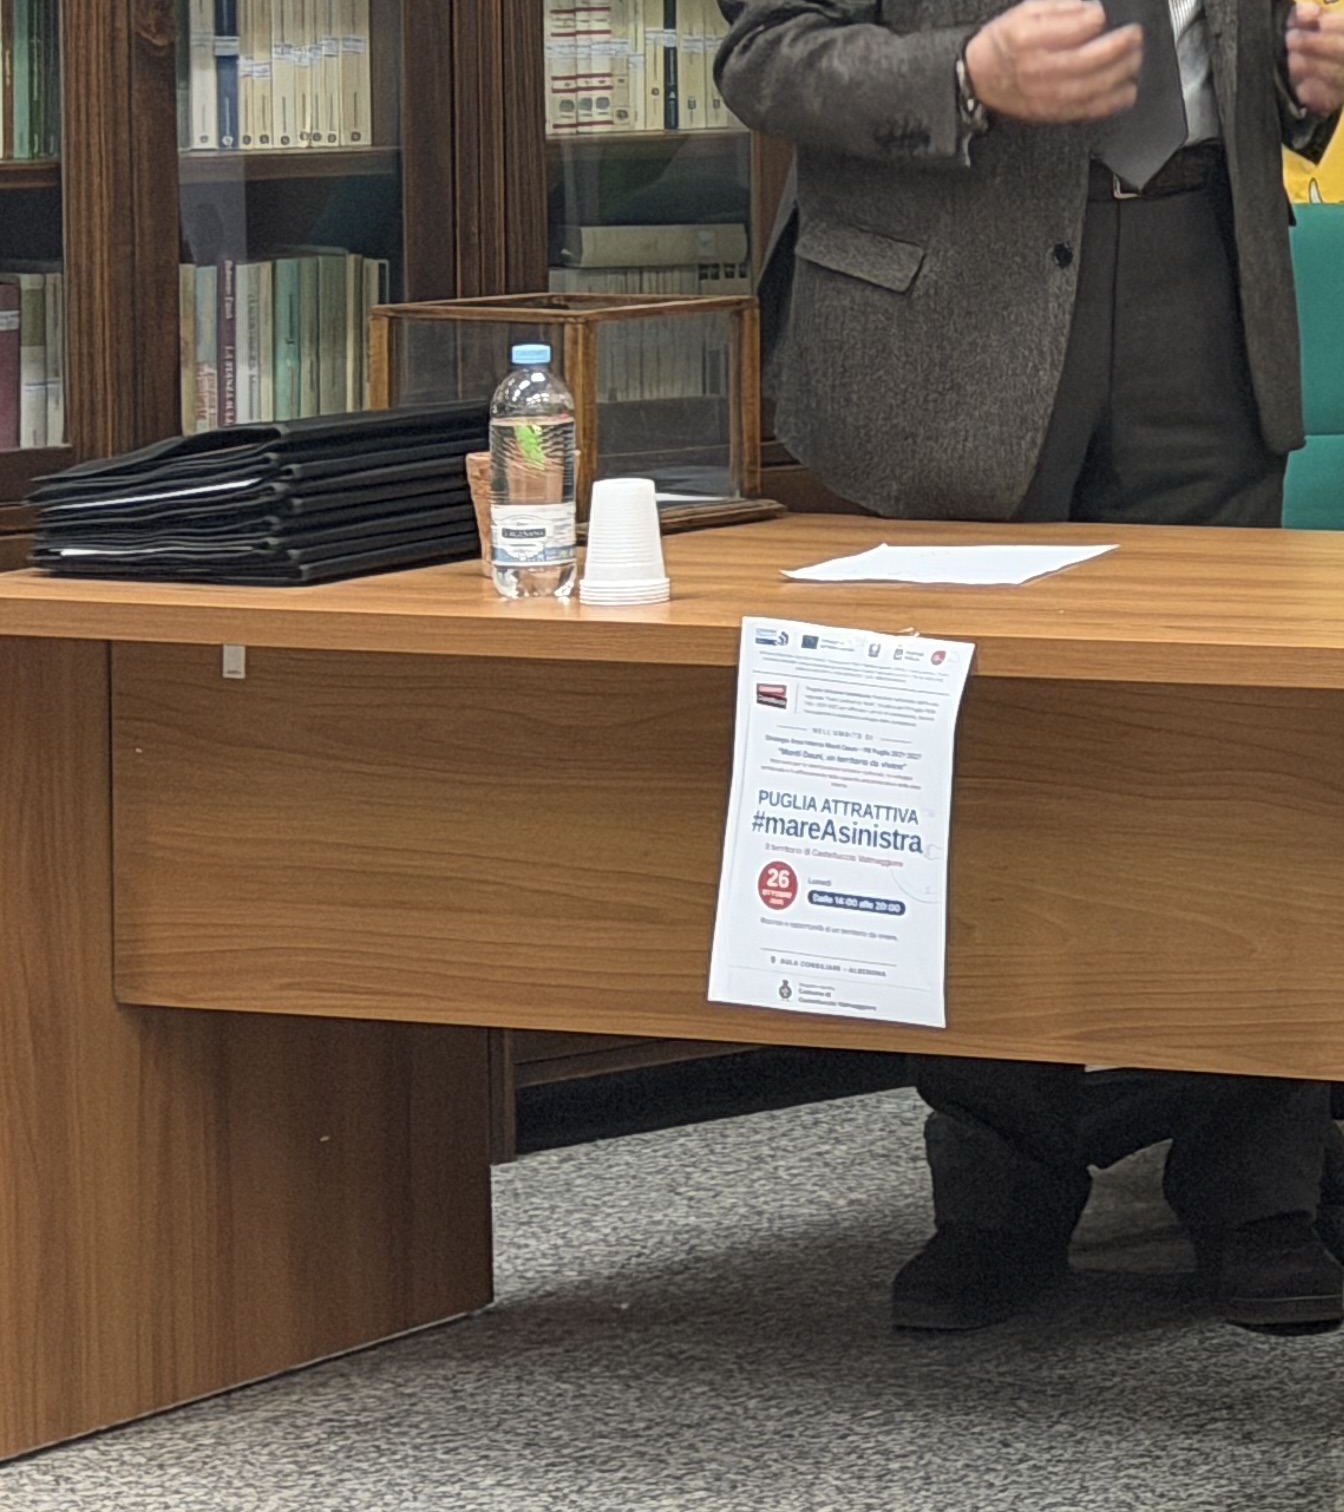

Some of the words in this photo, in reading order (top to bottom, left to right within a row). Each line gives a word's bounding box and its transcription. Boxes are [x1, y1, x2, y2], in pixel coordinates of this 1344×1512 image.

[758, 789, 817, 812] PUGLIA
[820, 798, 919, 825] ATTRATTIVA
[751, 809, 923, 854] #mareAsinistra
[767, 868, 790, 888] 26
